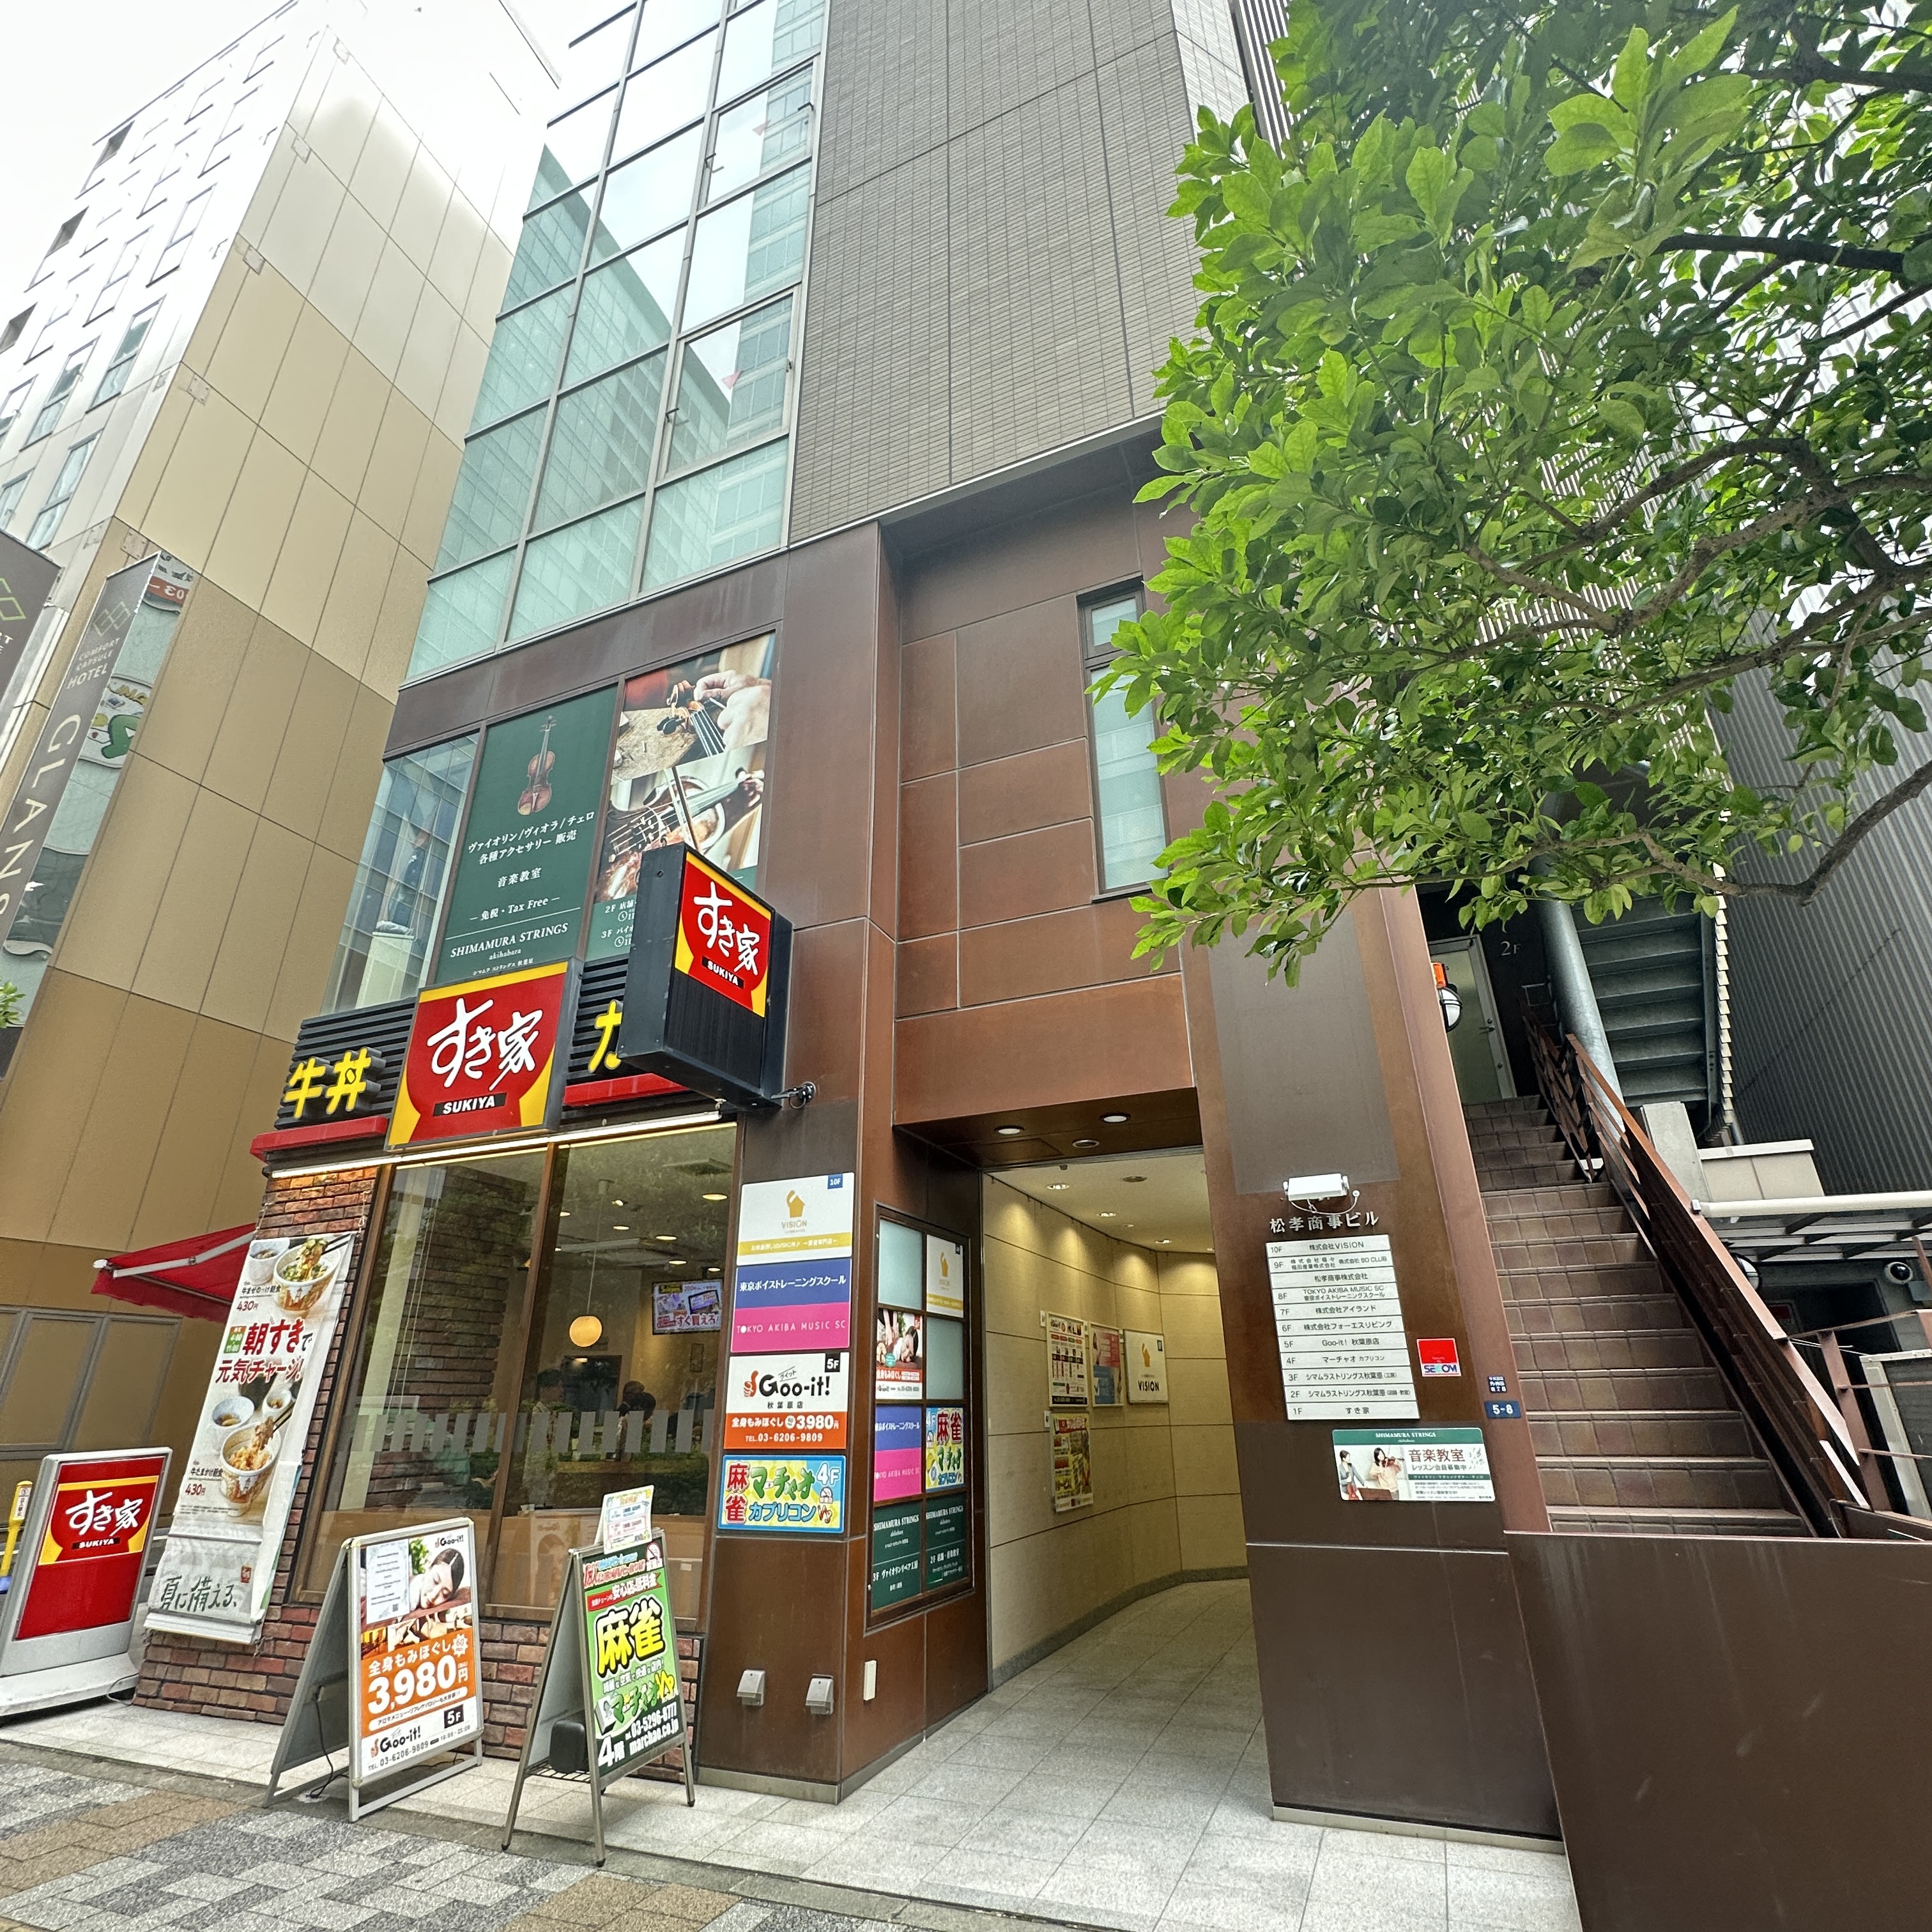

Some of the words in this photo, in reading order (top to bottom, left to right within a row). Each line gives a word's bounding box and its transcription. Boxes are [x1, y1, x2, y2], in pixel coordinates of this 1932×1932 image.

[66, 663, 109, 689] HOTEL
[479, 839, 552, 864] 各種アクセサリー
[555, 829, 577, 845] 販売
[497, 868, 542, 888] 音楽教室
[527, 897, 549, 909] Free
[605, 904, 616, 914] 2F
[601, 929, 613, 939] 3F
[693, 880, 760, 976] すき家
[450, 935, 516, 958] SHIMAMURA
[519, 923, 569, 942] STRINGS
[1500, 940, 1522, 956] 2F
[489, 949, 522, 960] akihabara
[707, 960, 739, 986] SUKIYA
[427, 997, 544, 1092] すき家
[284, 1046, 372, 1119] 牛丼
[443, 1094, 496, 1115] SUKIYA
[781, 1220, 808, 1229] VISION
[1269, 1211, 1379, 1234] 松孝商事ビル
[739, 1275, 847, 1292] 東京ボイストレーニングスクール
[1315, 1305, 1376, 1314] 株式会社アイランド
[737, 1324, 763, 1334] TOKYO
[768, 1322, 796, 1332] AKIBA
[801, 1321, 830, 1331] MUSIC
[835, 1319, 846, 1329] SC
[1351, 1337, 1380, 1346] 秋葉原店
[827, 1358, 839, 1369] 5F
[1423, 1364, 1457, 1373] SECOM
[758, 1374, 831, 1398] Goo-it!
[1138, 1380, 1160, 1392] VISION
[767, 1401, 804, 1409] 秋葉原店
[1492, 1404, 1514, 1414] 5-8
[731, 1416, 785, 1429] 全身もみほぐし
[937, 1411, 962, 1445] 麻雀
[1409, 1448, 1466, 1462] 音楽教室
[816, 1462, 841, 1486] 4F
[750, 1466, 815, 1501] マーチャオ
[725, 1462, 749, 1524] 麻雀
[65, 1489, 144, 1537] すき家
[749, 1501, 817, 1522] カプリコン
[873, 1517, 901, 1531] SHIMAMURA
[901, 1514, 919, 1526] STRINGS
[79, 1537, 115, 1549] SUKIYA
[440, 1534, 464, 1547] Goo-it!
[873, 1571, 880, 1581] 3F
[595, 1597, 665, 1678] 麻雀
[369, 1639, 452, 1678] 全身もみほぐし
[447, 1710, 461, 1725] 5F
[379, 1725, 422, 1753] Goo-it!
[629, 1717, 679, 1755] marchao.co.jp
